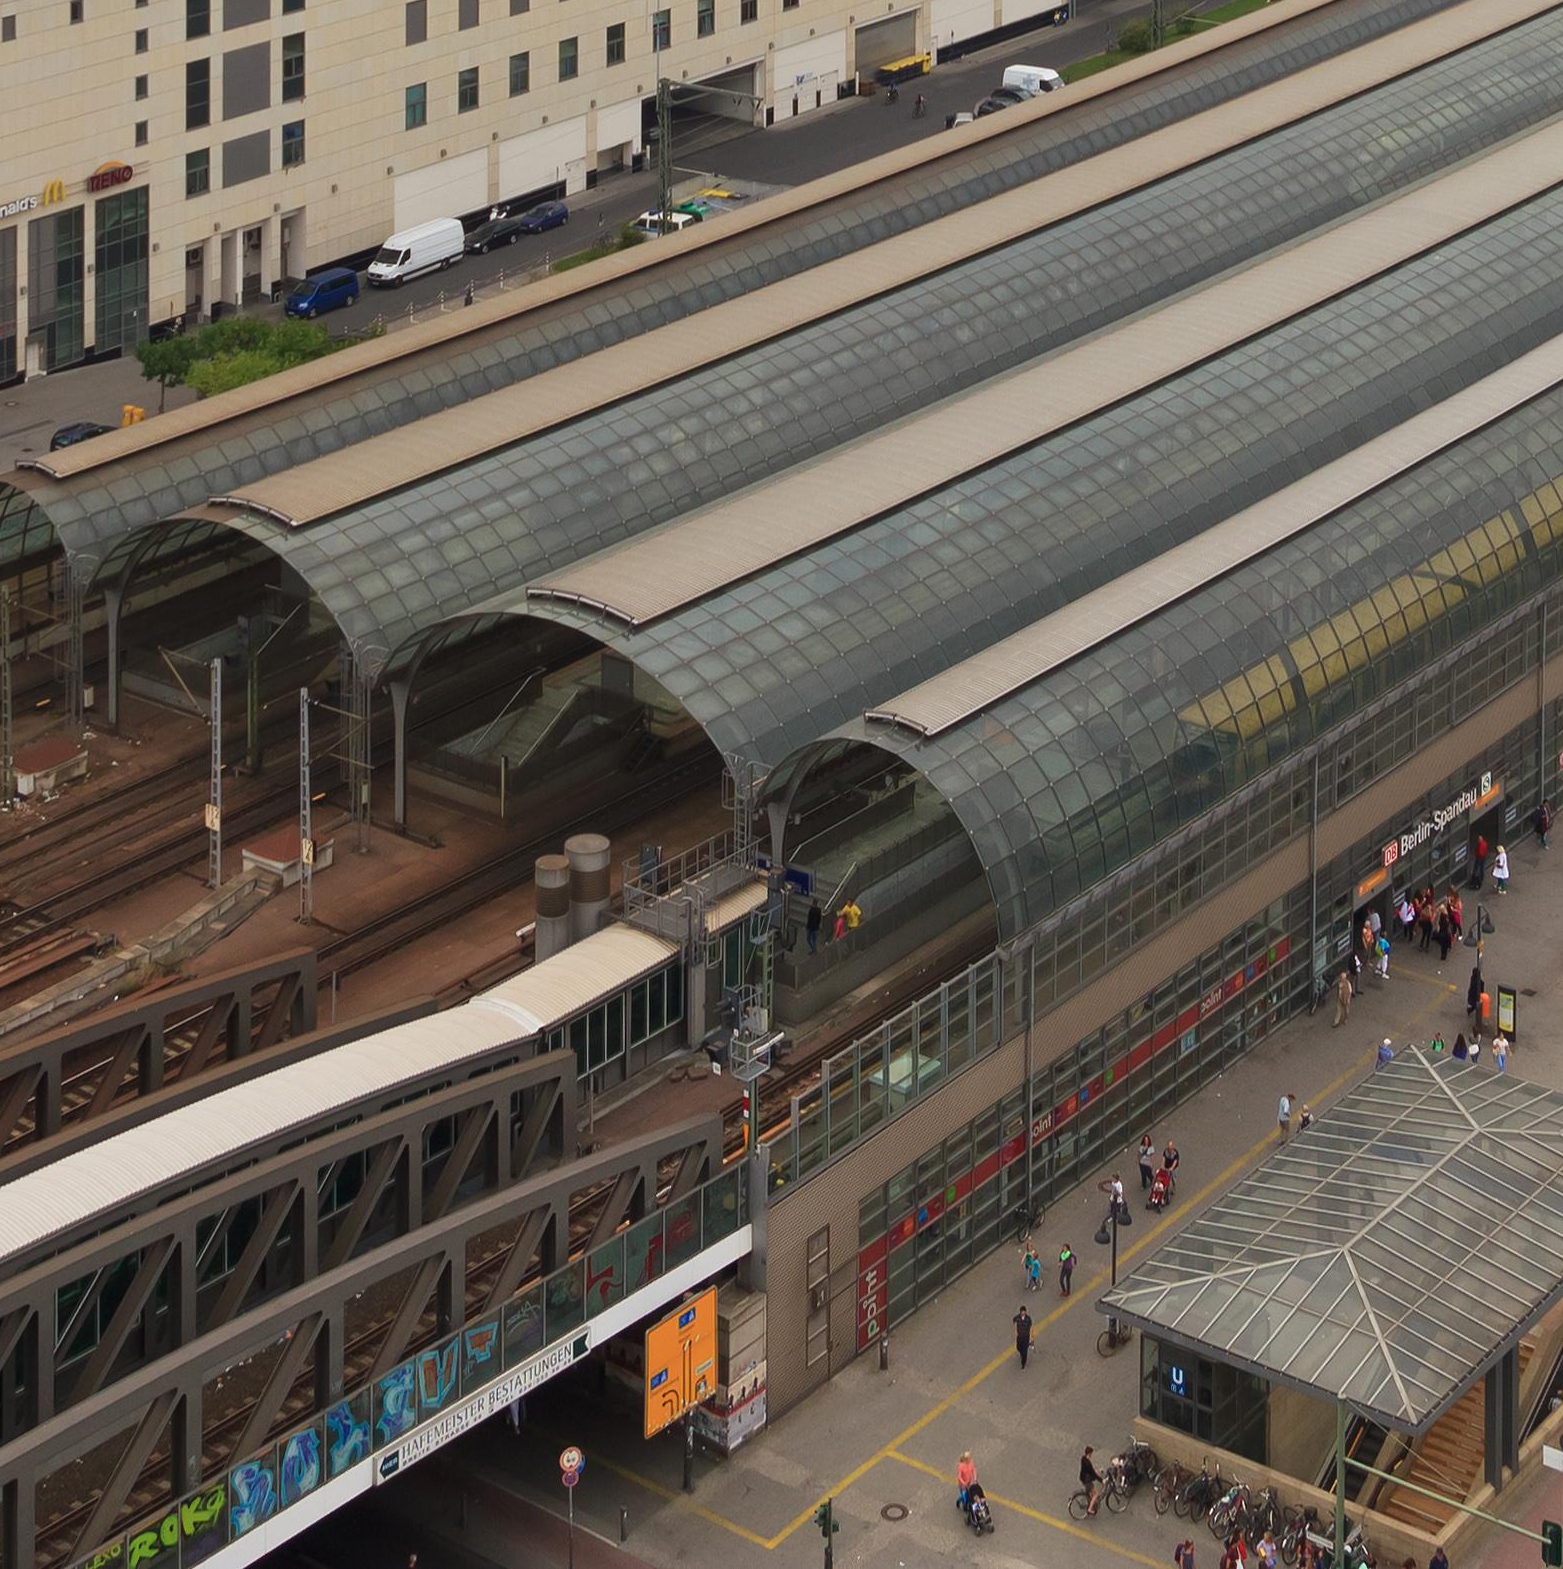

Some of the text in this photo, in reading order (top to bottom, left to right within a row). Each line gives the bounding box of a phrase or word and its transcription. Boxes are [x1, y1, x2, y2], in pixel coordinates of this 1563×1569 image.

[87, 165, 133, 193] RENO
[1385, 787, 1478, 864] DB Berlin-Spandau
[863, 1270, 880, 1340] point
[401, 1397, 486, 1461] HAFEMEISTER
[488, 1342, 573, 1407] BESTATTUNGEN
[1172, 1366, 1183, 1385] U
